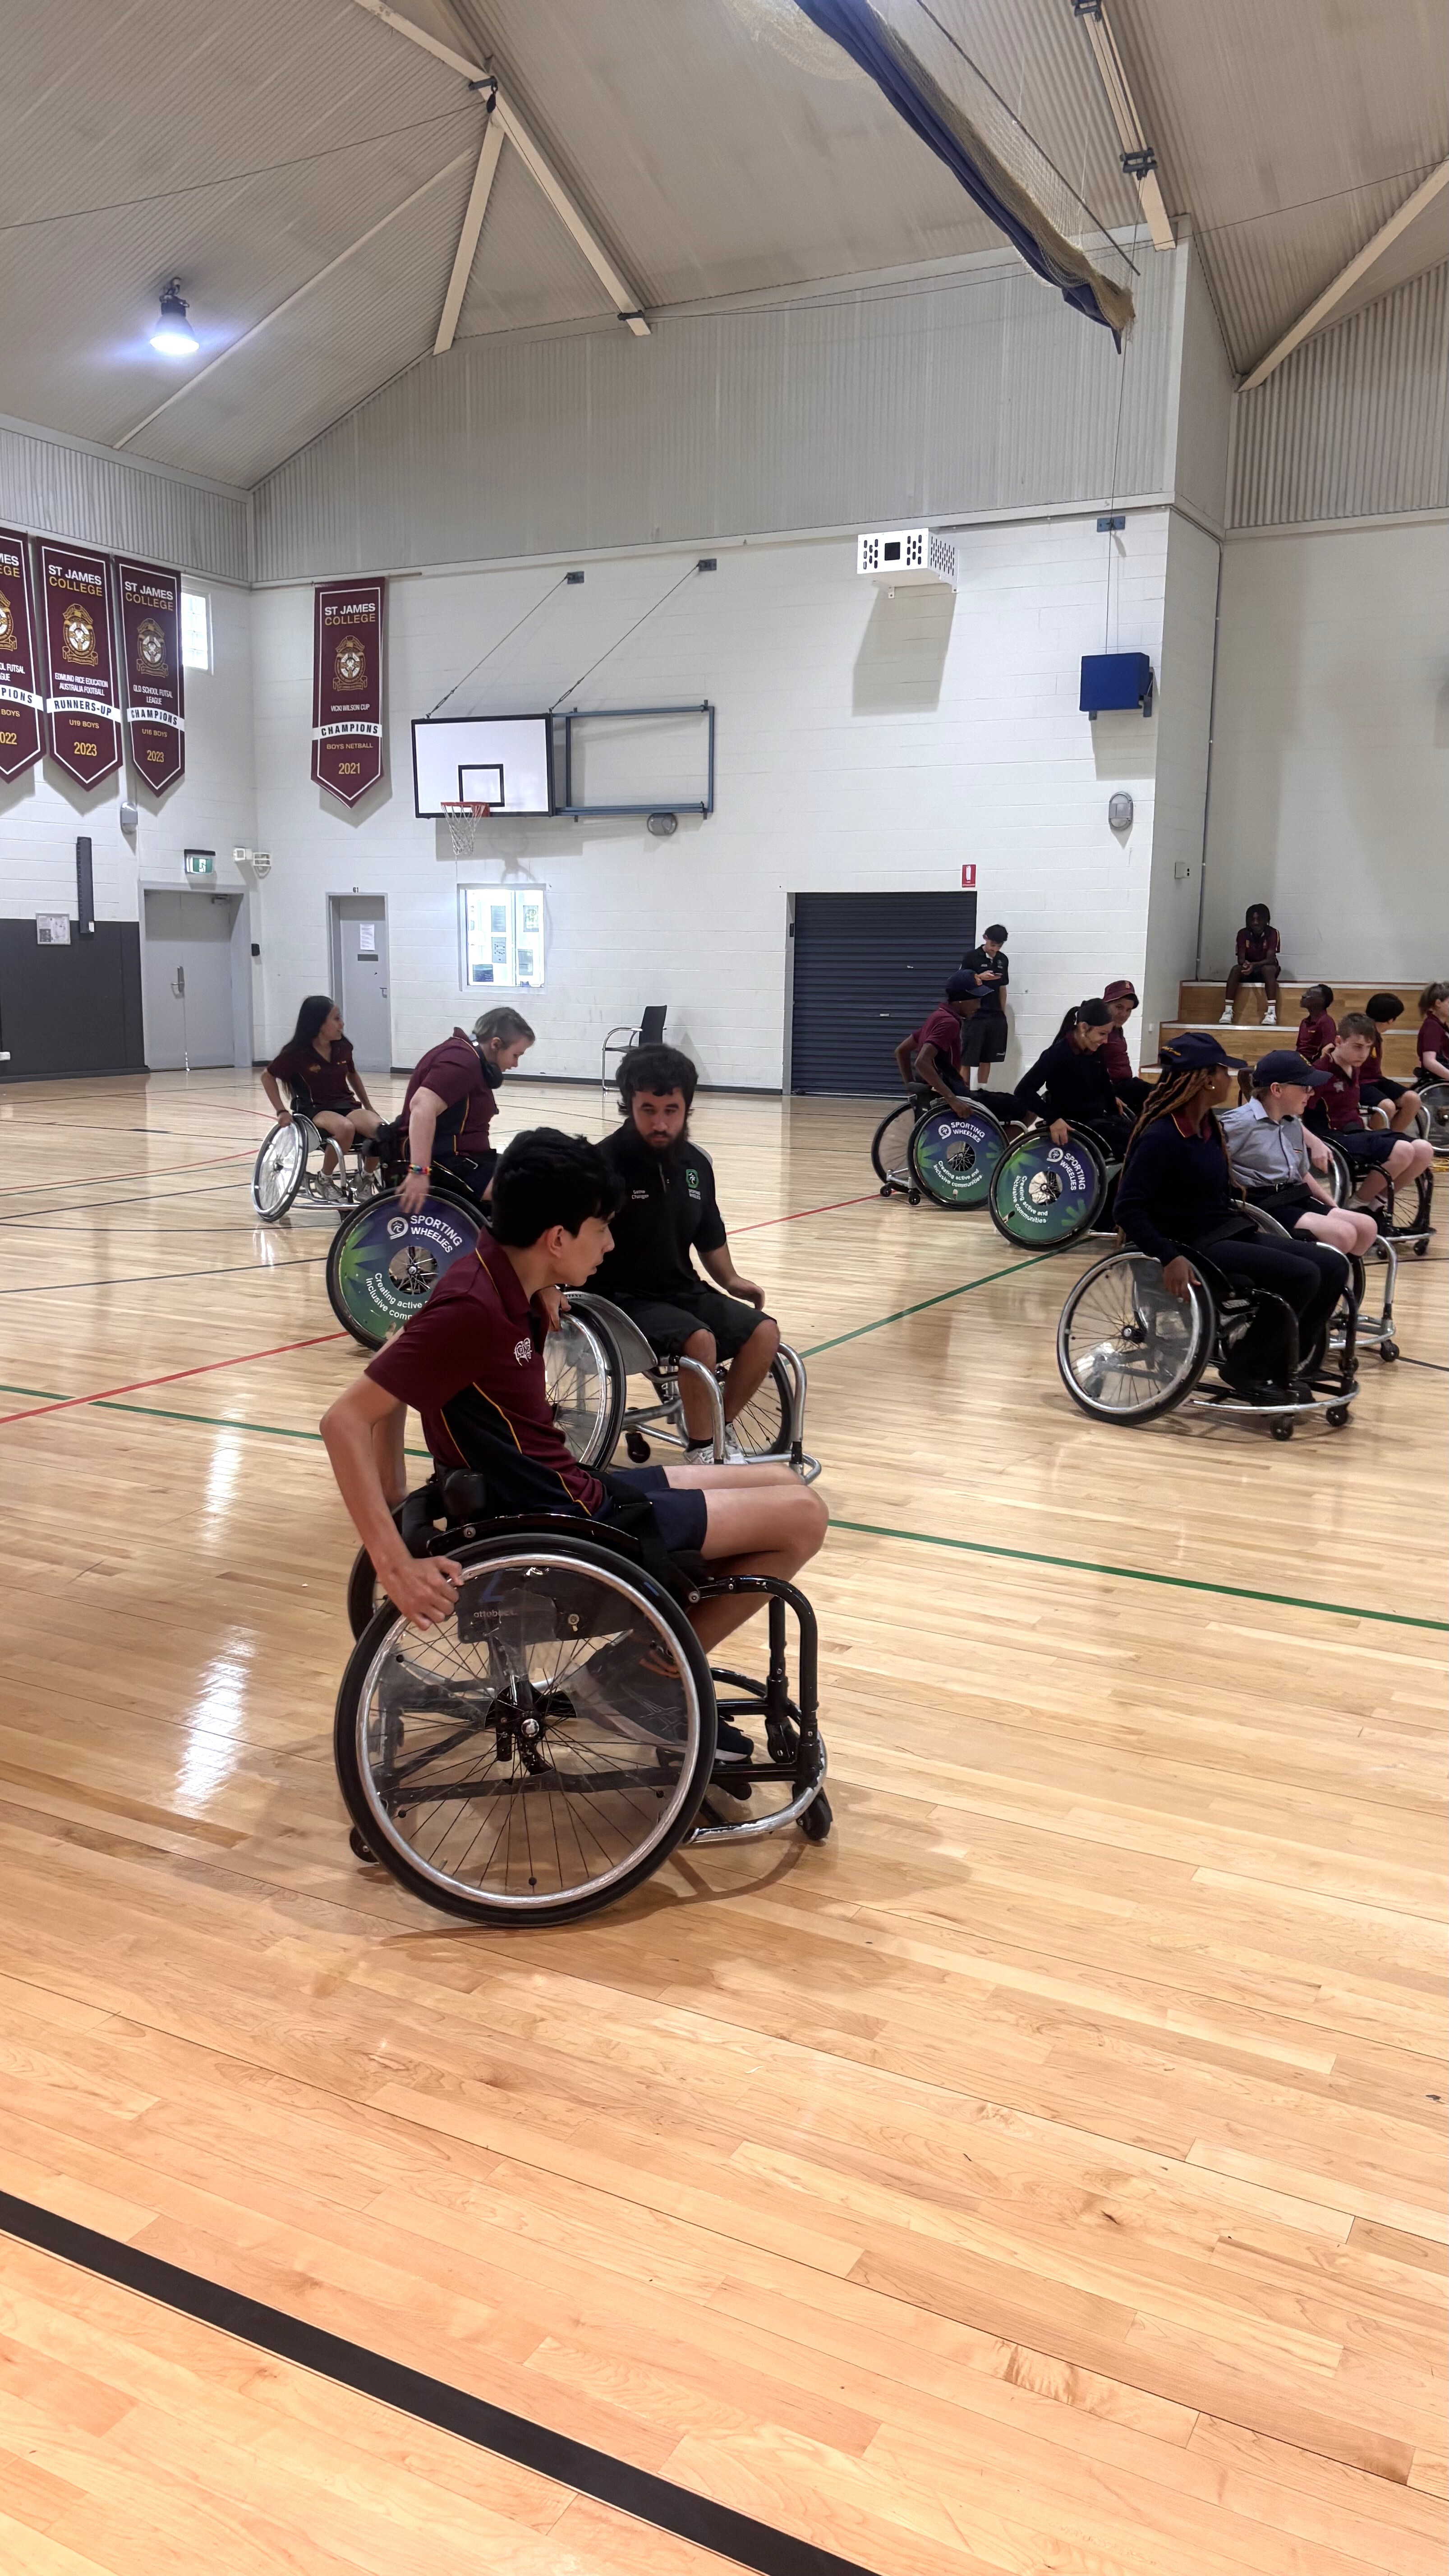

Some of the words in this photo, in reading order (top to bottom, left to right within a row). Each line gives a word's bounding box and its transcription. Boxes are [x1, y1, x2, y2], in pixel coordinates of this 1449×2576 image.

[48, 565, 62, 576] ST
[65, 569, 102, 585] JAMES
[49, 576, 103, 597] COLLEGE
[124, 581, 138, 592] ST
[140, 585, 174, 600] JAMES
[125, 592, 174, 611] COLLEGE
[325, 607, 338, 616] ST
[340, 603, 376, 615] JAMES
[325, 613, 376, 626] COLLEGE
[6, 663, 25, 674] FUTSAL
[55, 672, 74, 682] EDMUND
[85, 677, 108, 688] EDUCATION
[1, 687, 32, 704] PIONS
[59, 682, 83, 693] AUSTRALIA
[84, 686, 105, 696] FOOTBALL
[133, 684, 142, 692] OLD
[142, 685, 159, 695] SCHOOL
[54, 699, 112, 716] RUNNERS-UP
[146, 696, 162, 705] LEAGUE
[1, 708, 20, 717] BOYS
[131, 709, 178, 725] CHAMPIONS
[321, 723, 378, 736] CHAMPIONS
[0, 731, 17, 745] 022
[74, 742, 97, 756] 2023
[147, 750, 164, 763] 2023
[339, 763, 360, 774] 2021
[951, 1122, 985, 1138] SPORTING
[952, 1128, 981, 1143] WHEELIES
[1060, 1159, 1077, 1191] WHEELIES
[1064, 1153, 1086, 1190] SPORTING
[410, 1215, 463, 1247] SPORTING
[410, 1227, 453, 1253] WHEELIES
[366, 1278, 388, 1311] Inclusive
[375, 1273, 396, 1305] Creating
[397, 1301, 423, 1309] active
